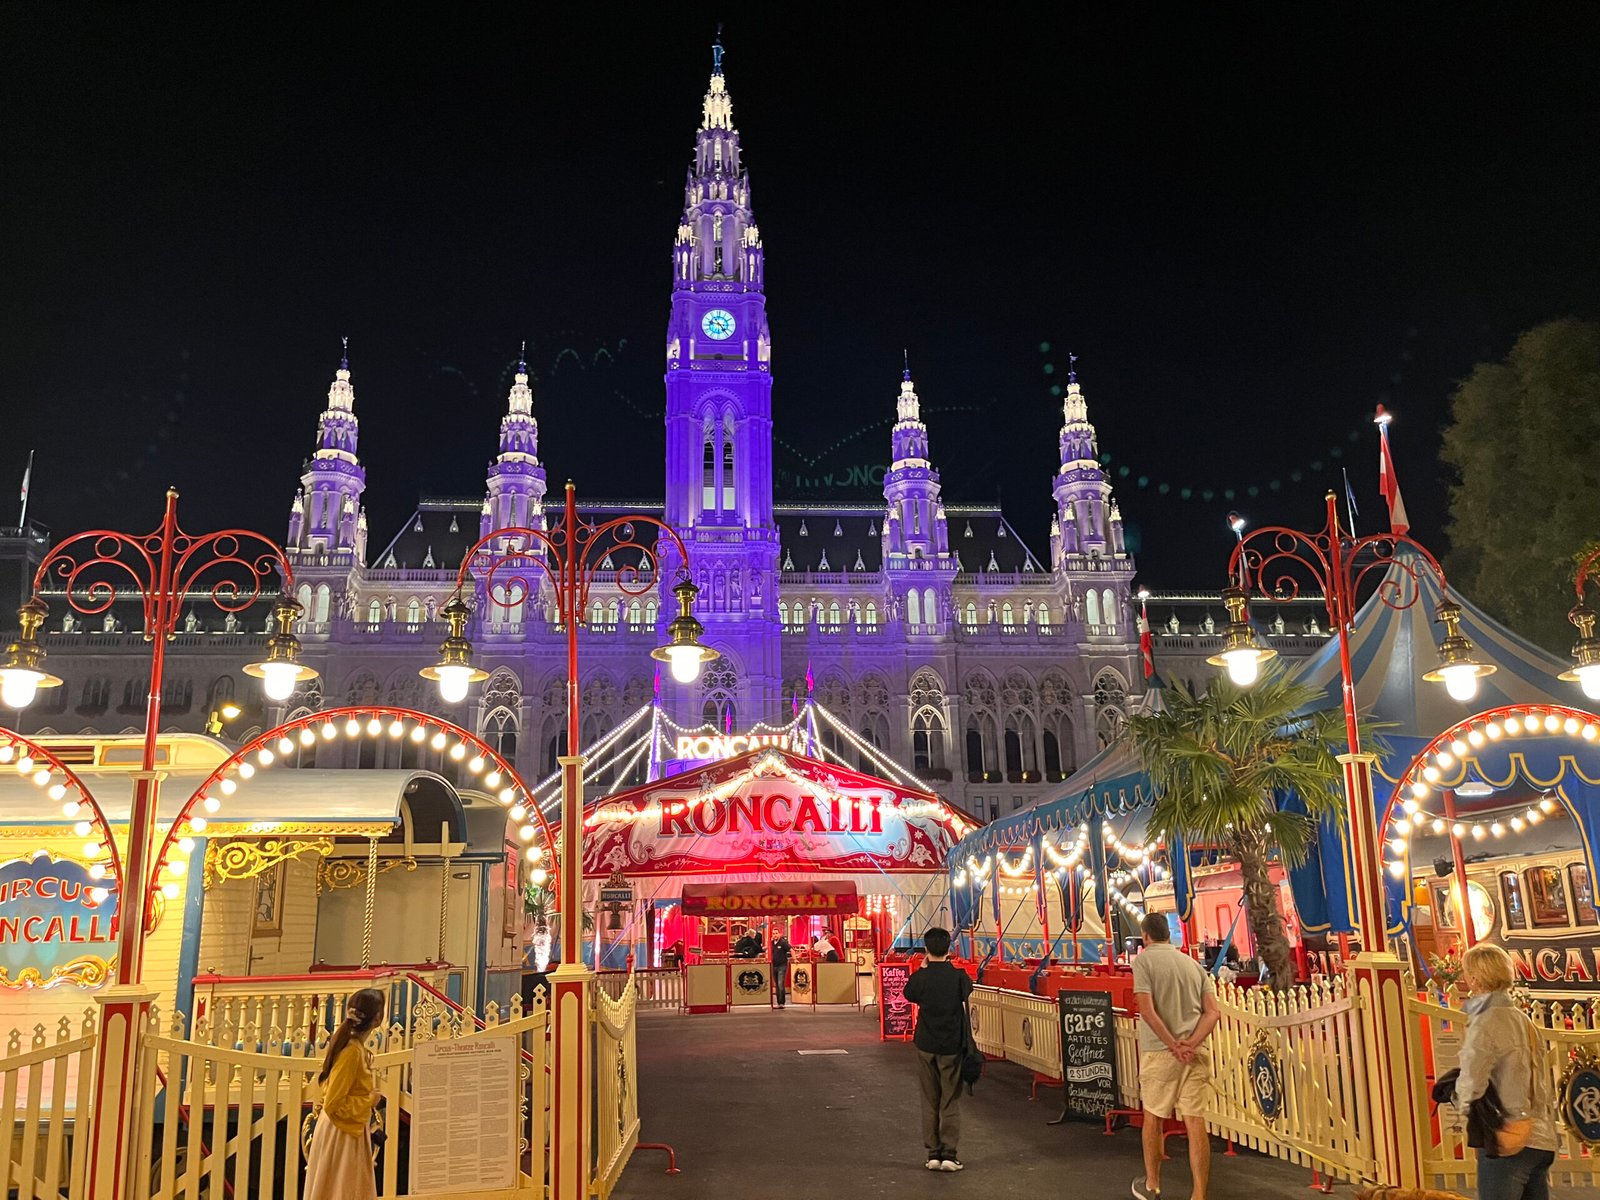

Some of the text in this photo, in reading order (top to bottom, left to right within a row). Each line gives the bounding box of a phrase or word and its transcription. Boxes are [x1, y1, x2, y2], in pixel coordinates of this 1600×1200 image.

[657, 793, 885, 837] RONCALLI
[705, 894, 838, 911] RONCALLI
[1065, 1012, 1105, 1034] Café
[1067, 1034, 1108, 1045] ARTISTES
[1069, 1065, 1110, 1079] 2 STUNDEN
[1097, 1079, 1112, 1089] VOR
